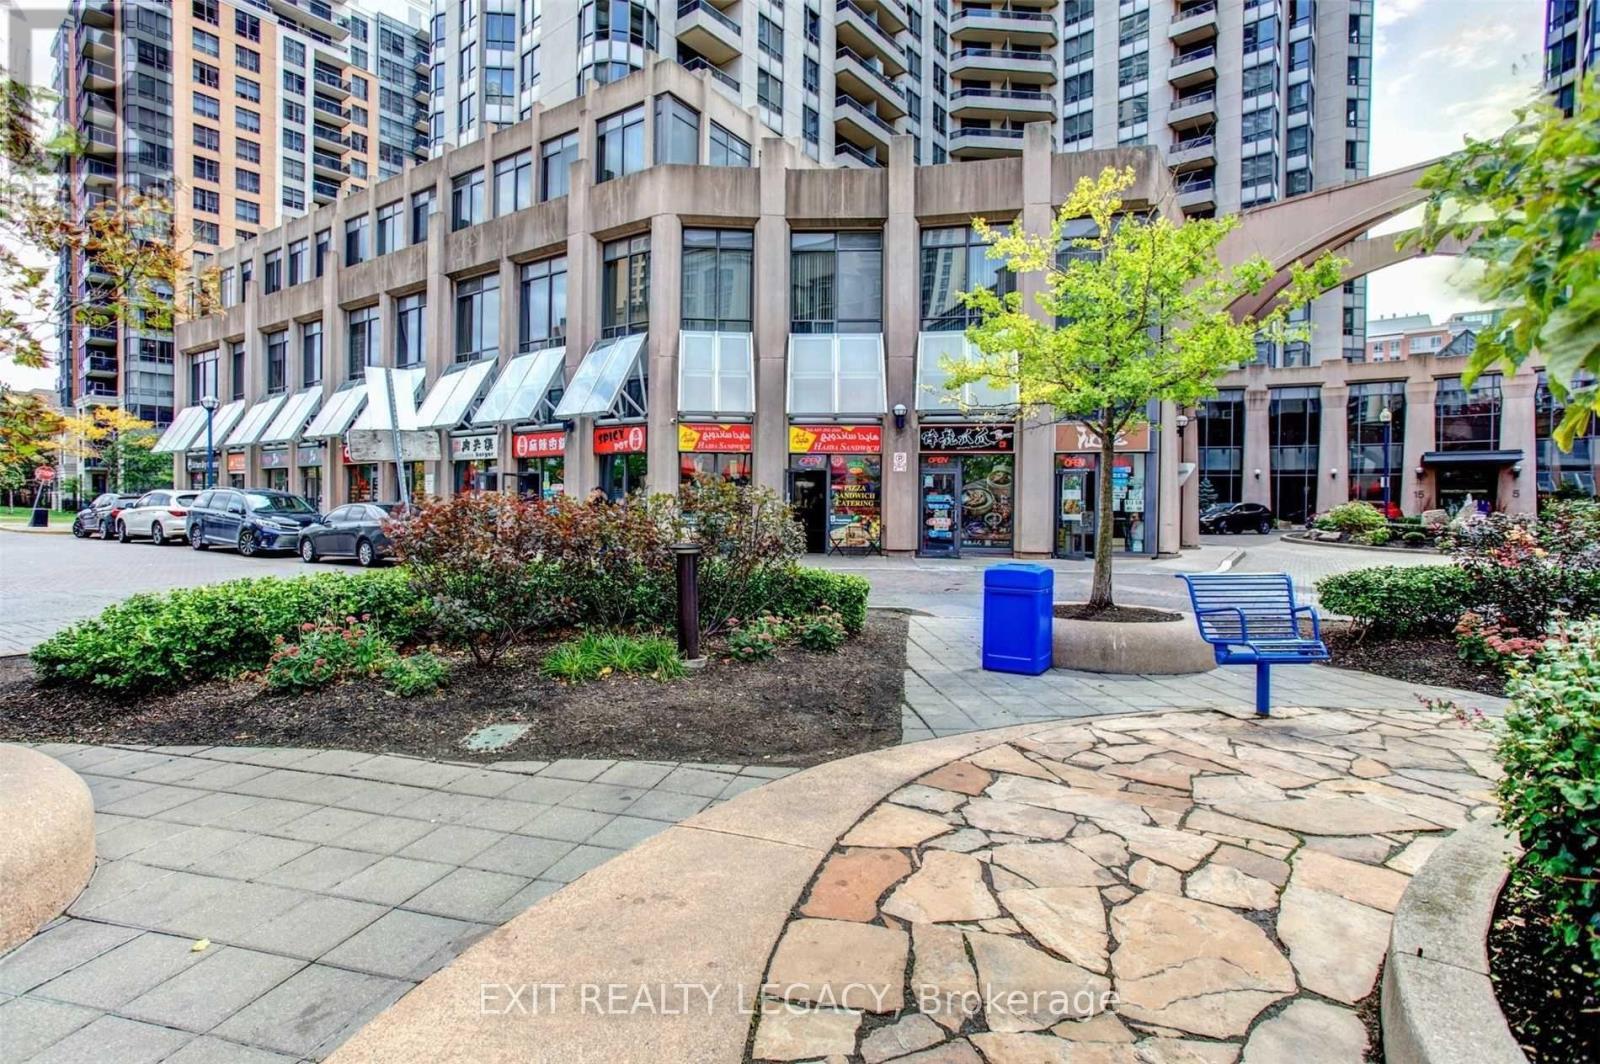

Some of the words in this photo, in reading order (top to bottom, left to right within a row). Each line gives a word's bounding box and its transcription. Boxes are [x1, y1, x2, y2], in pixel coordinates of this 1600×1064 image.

[598, 429, 624, 444] SPICY
[614, 440, 629, 451] POT
[928, 456, 950, 464] OPEN
[1414, 490, 1425, 499] 15
[1512, 489, 1520, 498] 5
